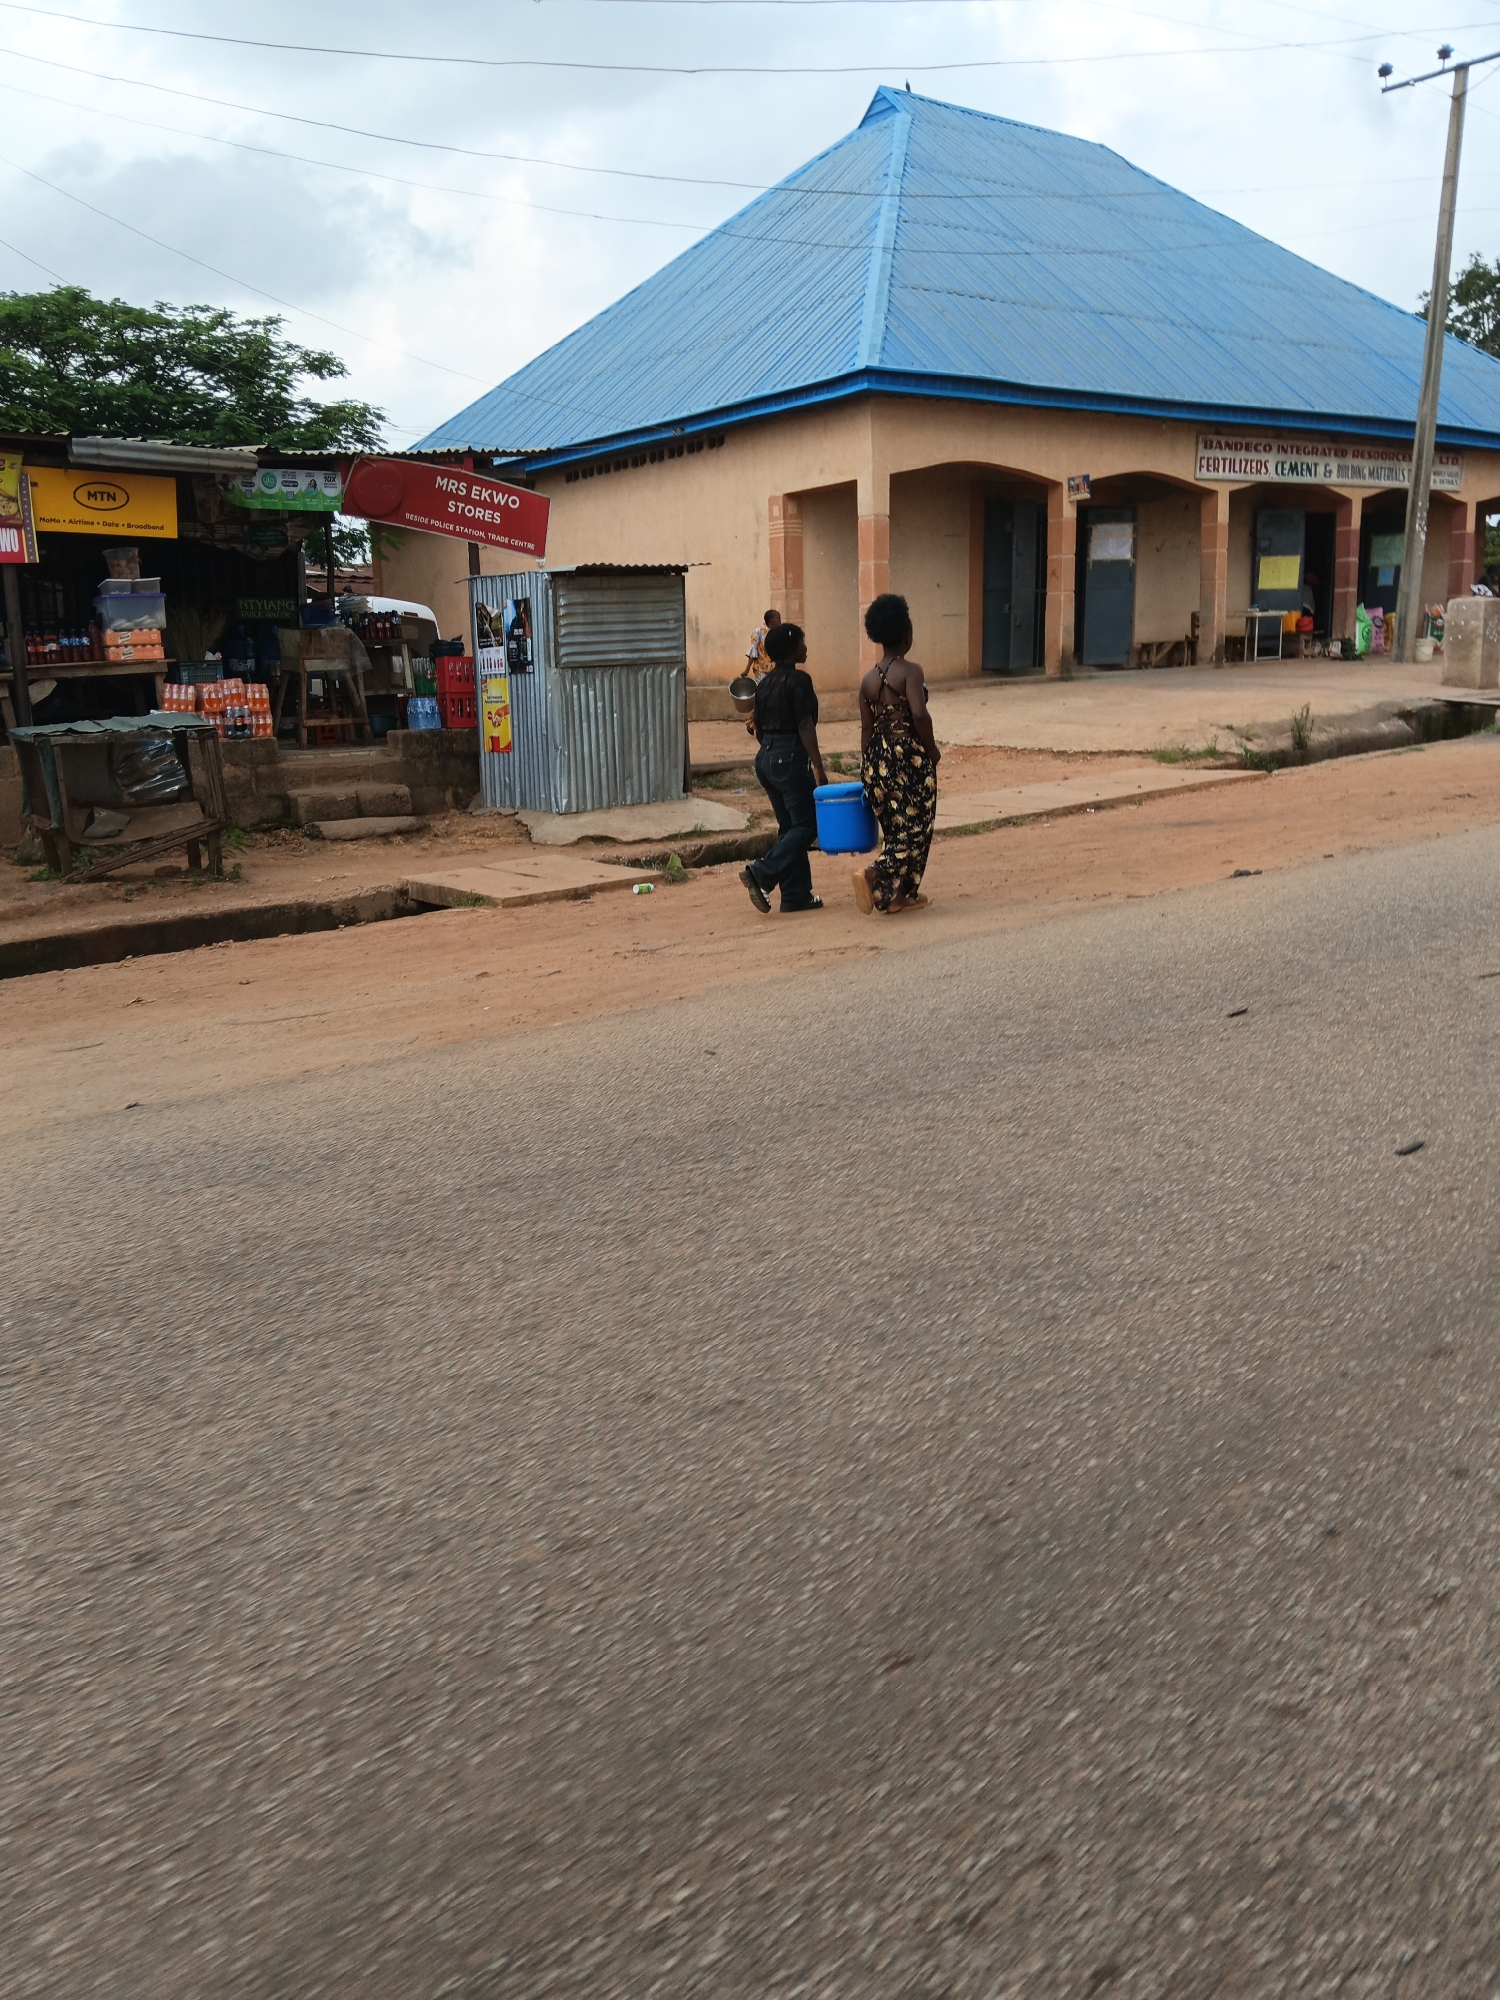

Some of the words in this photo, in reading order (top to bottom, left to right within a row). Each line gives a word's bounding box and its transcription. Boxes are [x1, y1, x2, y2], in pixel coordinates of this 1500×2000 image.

[1203, 439, 1273, 453] BANDECO
[1277, 444, 1348, 458] INTEGRATED
[1274, 460, 1320, 478] CEMENT
[1323, 462, 1333, 479] &
[1336, 463, 1367, 481] BUILDING
[1367, 464, 1406, 483] MATERIALS
[87, 490, 117, 502] MTN
[435, 475, 467, 496] MRS
[471, 485, 520, 509] EKWO
[447, 500, 501, 524] STORES
[68, 518, 94, 526] Airtime
[102, 520, 119, 528] Data
[127, 522, 164, 531] Broadband
[405, 512, 429, 525] BESIDE
[430, 519, 454, 531] POLICE
[455, 525, 486, 539] STATION,
[488, 532, 509, 544] TRADE
[510, 538, 536, 551] CENTRE
[240, 610, 263, 618] TABLE
